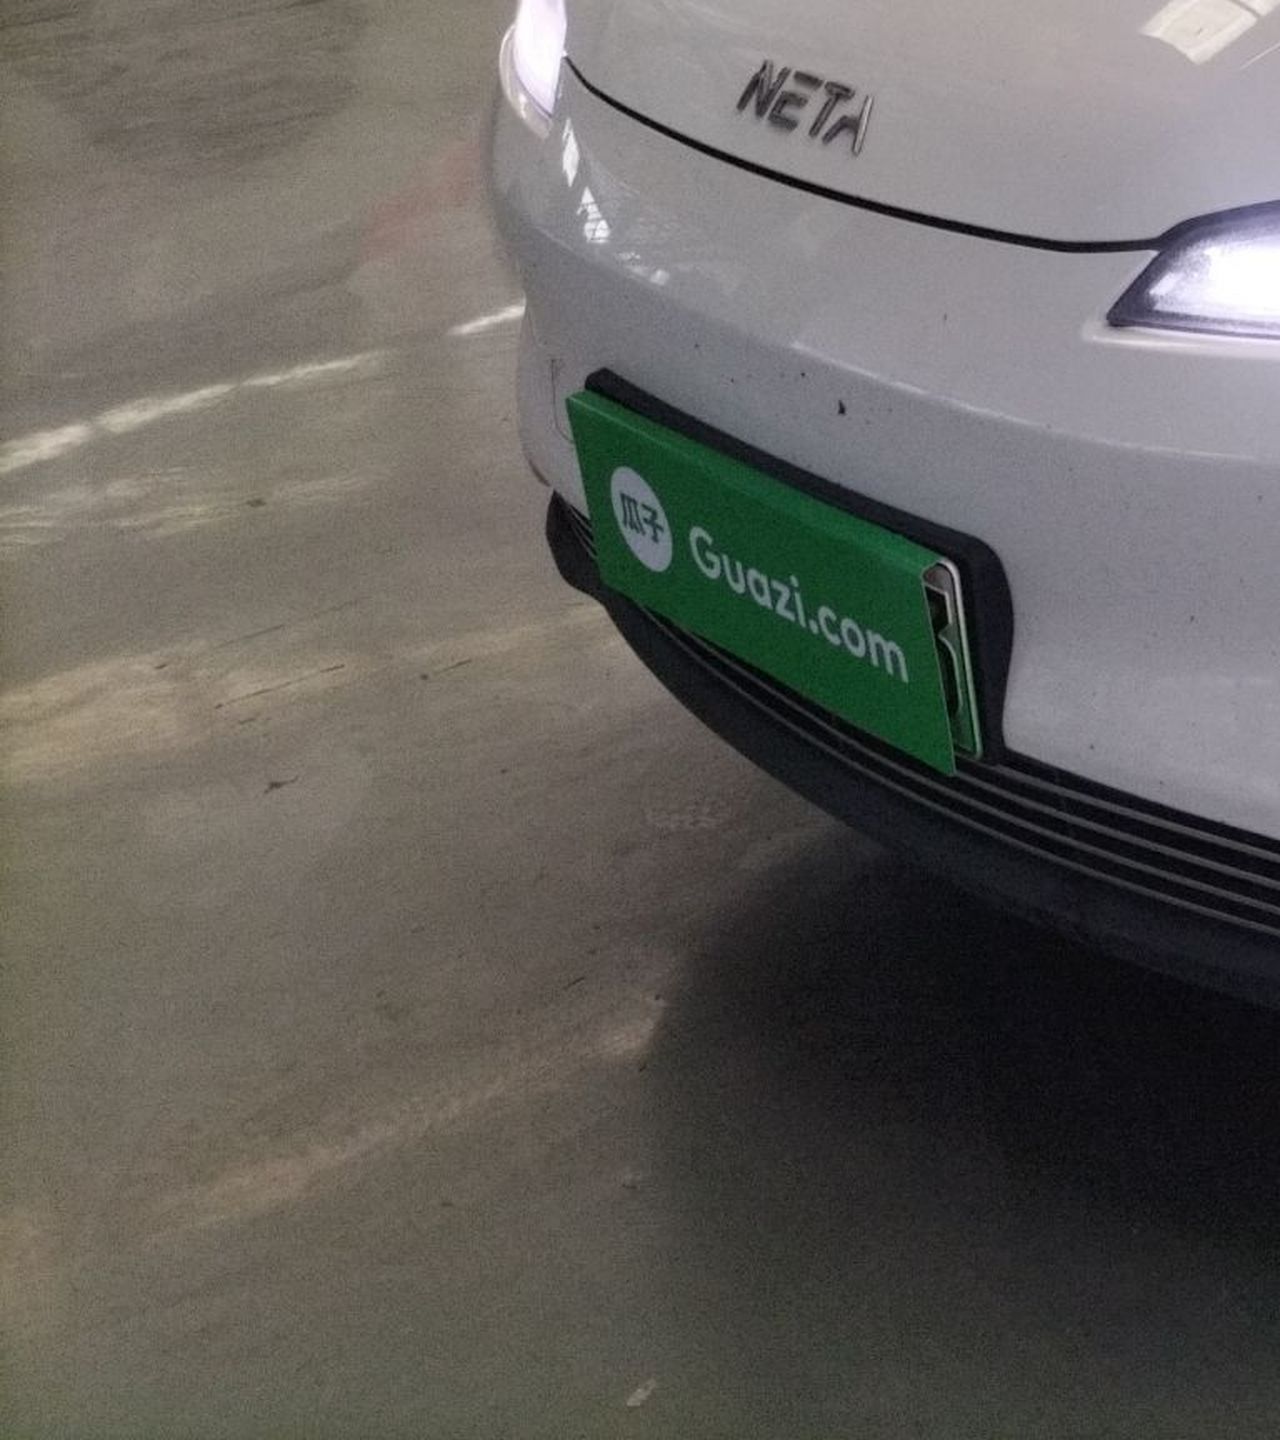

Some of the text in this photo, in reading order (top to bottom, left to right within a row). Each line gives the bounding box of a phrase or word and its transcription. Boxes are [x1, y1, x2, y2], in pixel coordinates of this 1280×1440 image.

[736, 59, 875, 158] NETA
[618, 492, 665, 545] 瓜子
[689, 526, 910, 684] Guazi.com
